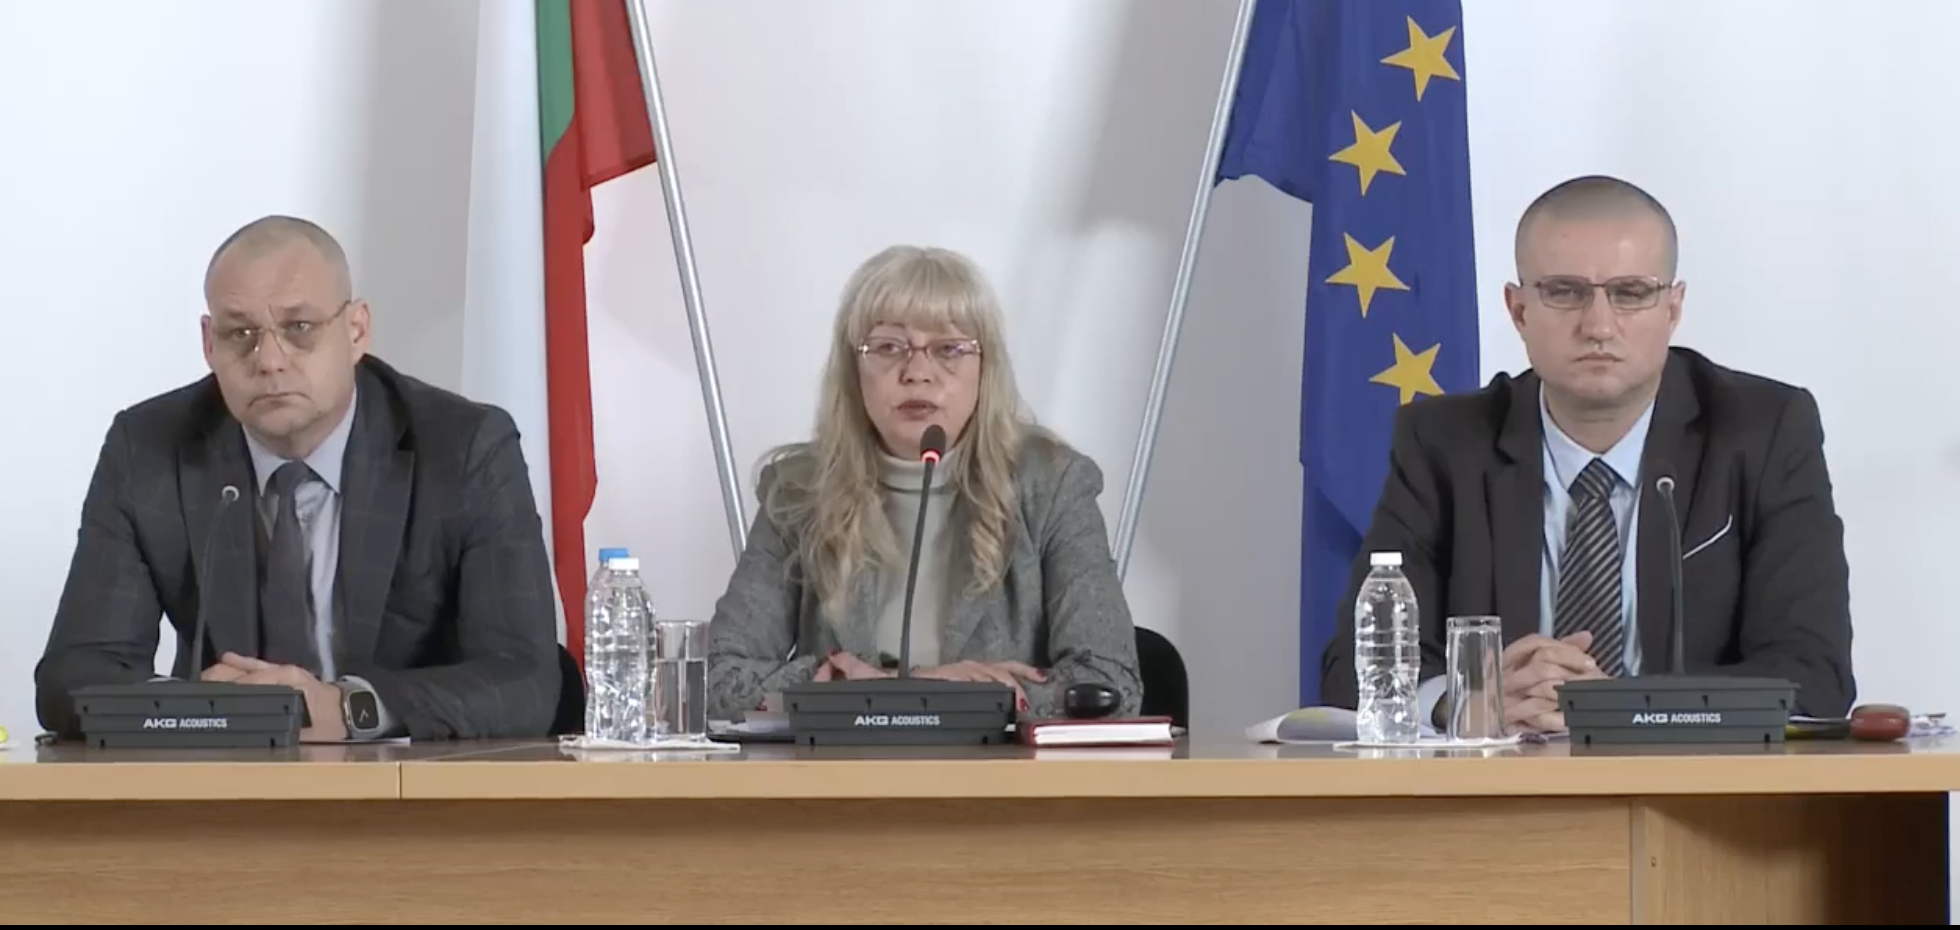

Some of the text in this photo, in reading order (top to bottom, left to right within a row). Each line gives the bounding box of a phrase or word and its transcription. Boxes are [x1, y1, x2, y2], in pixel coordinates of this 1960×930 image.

[143, 718, 227, 729] AKG ACOUSTICS
[854, 715, 940, 726] AKG ACOUSTICS
[1632, 713, 1721, 724] AKG ACOUSTICS
